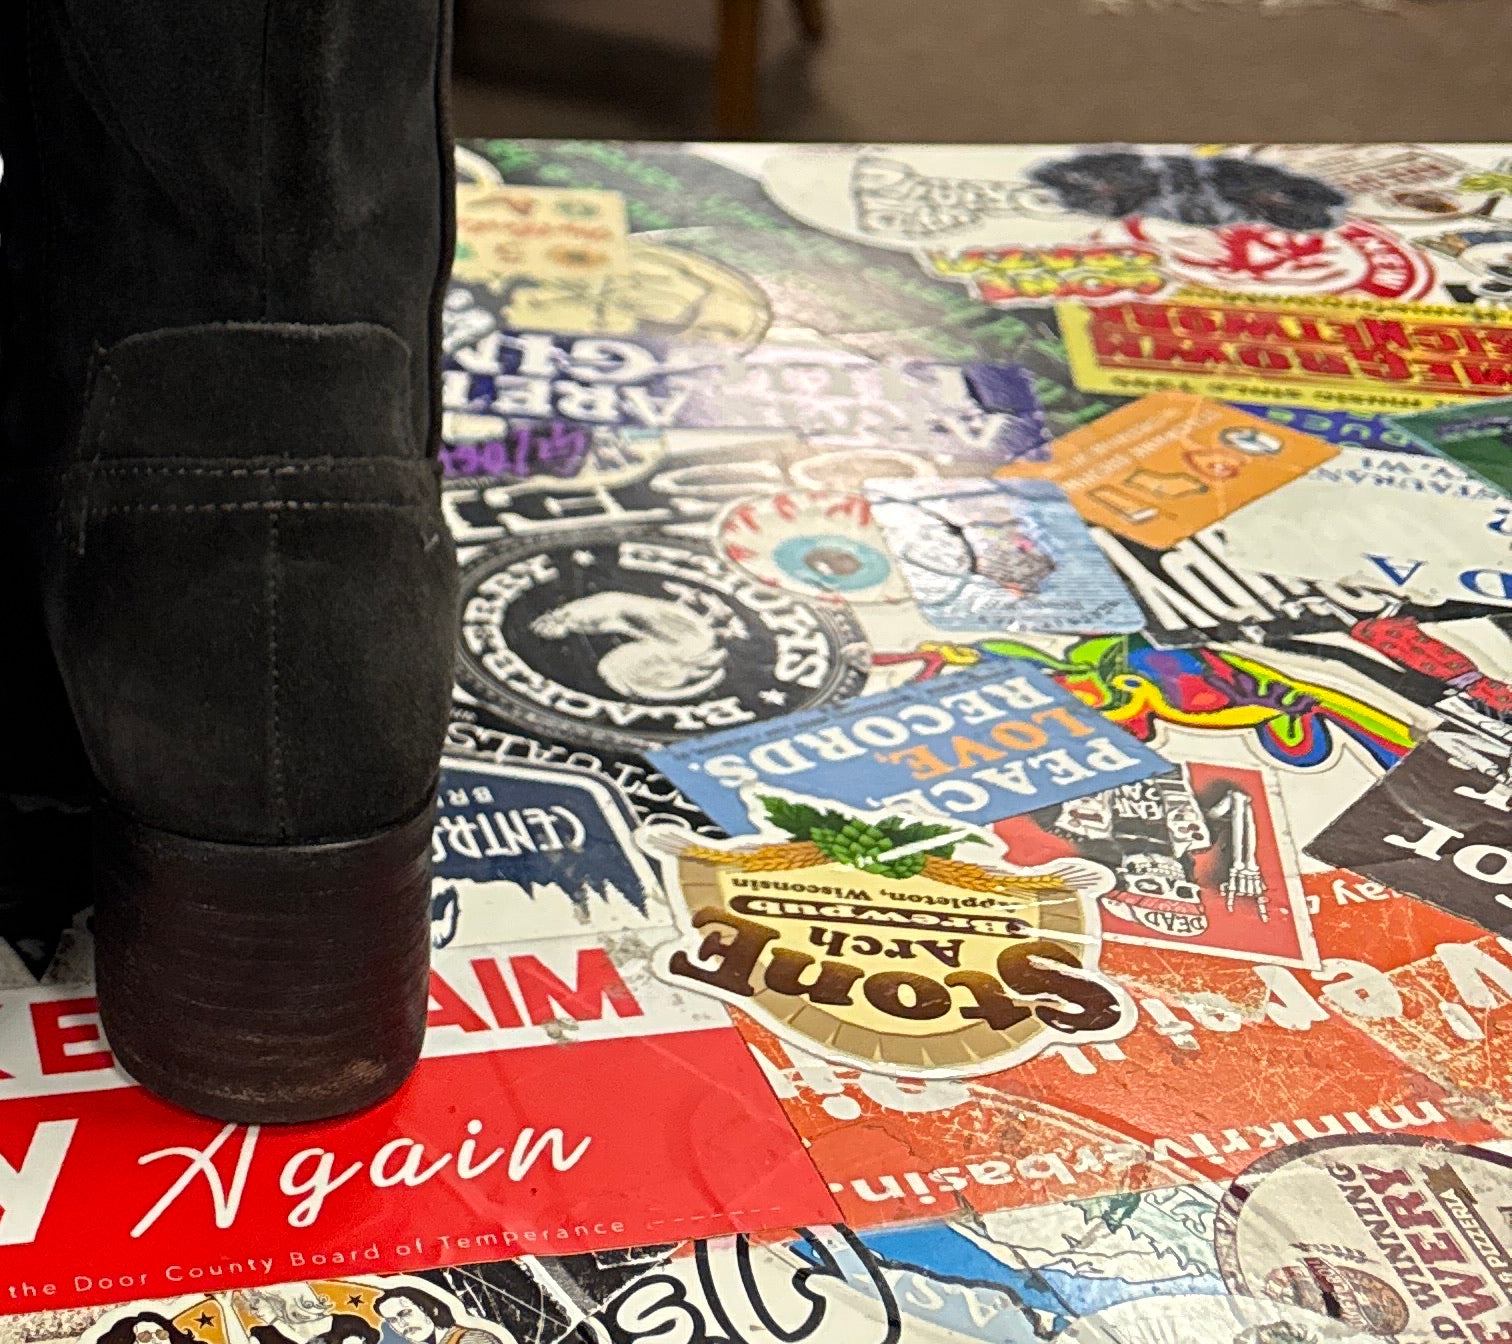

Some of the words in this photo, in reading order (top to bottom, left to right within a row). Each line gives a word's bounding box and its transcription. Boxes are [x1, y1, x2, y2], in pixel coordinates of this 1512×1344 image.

[689, 677, 1052, 787] RECORDS.
[731, 877, 873, 903] Wisconsin
[745, 898, 1012, 937] Brewpub
[1143, 911, 1204, 934] DEAD
[807, 926, 963, 969] Arch
[129, 1118, 592, 1238] Again
[8, 1278, 57, 1300] the
[74, 1268, 150, 1294] Door
[165, 1255, 275, 1282] County
[288, 1244, 381, 1270] Board
[395, 1235, 426, 1257] of
[437, 1216, 628, 1252] Temperance
[1325, 1162, 1441, 1309] WINNING
[1357, 1163, 1512, 1344] EWERY
[1439, 1187, 1504, 1274] PIZZERIA
